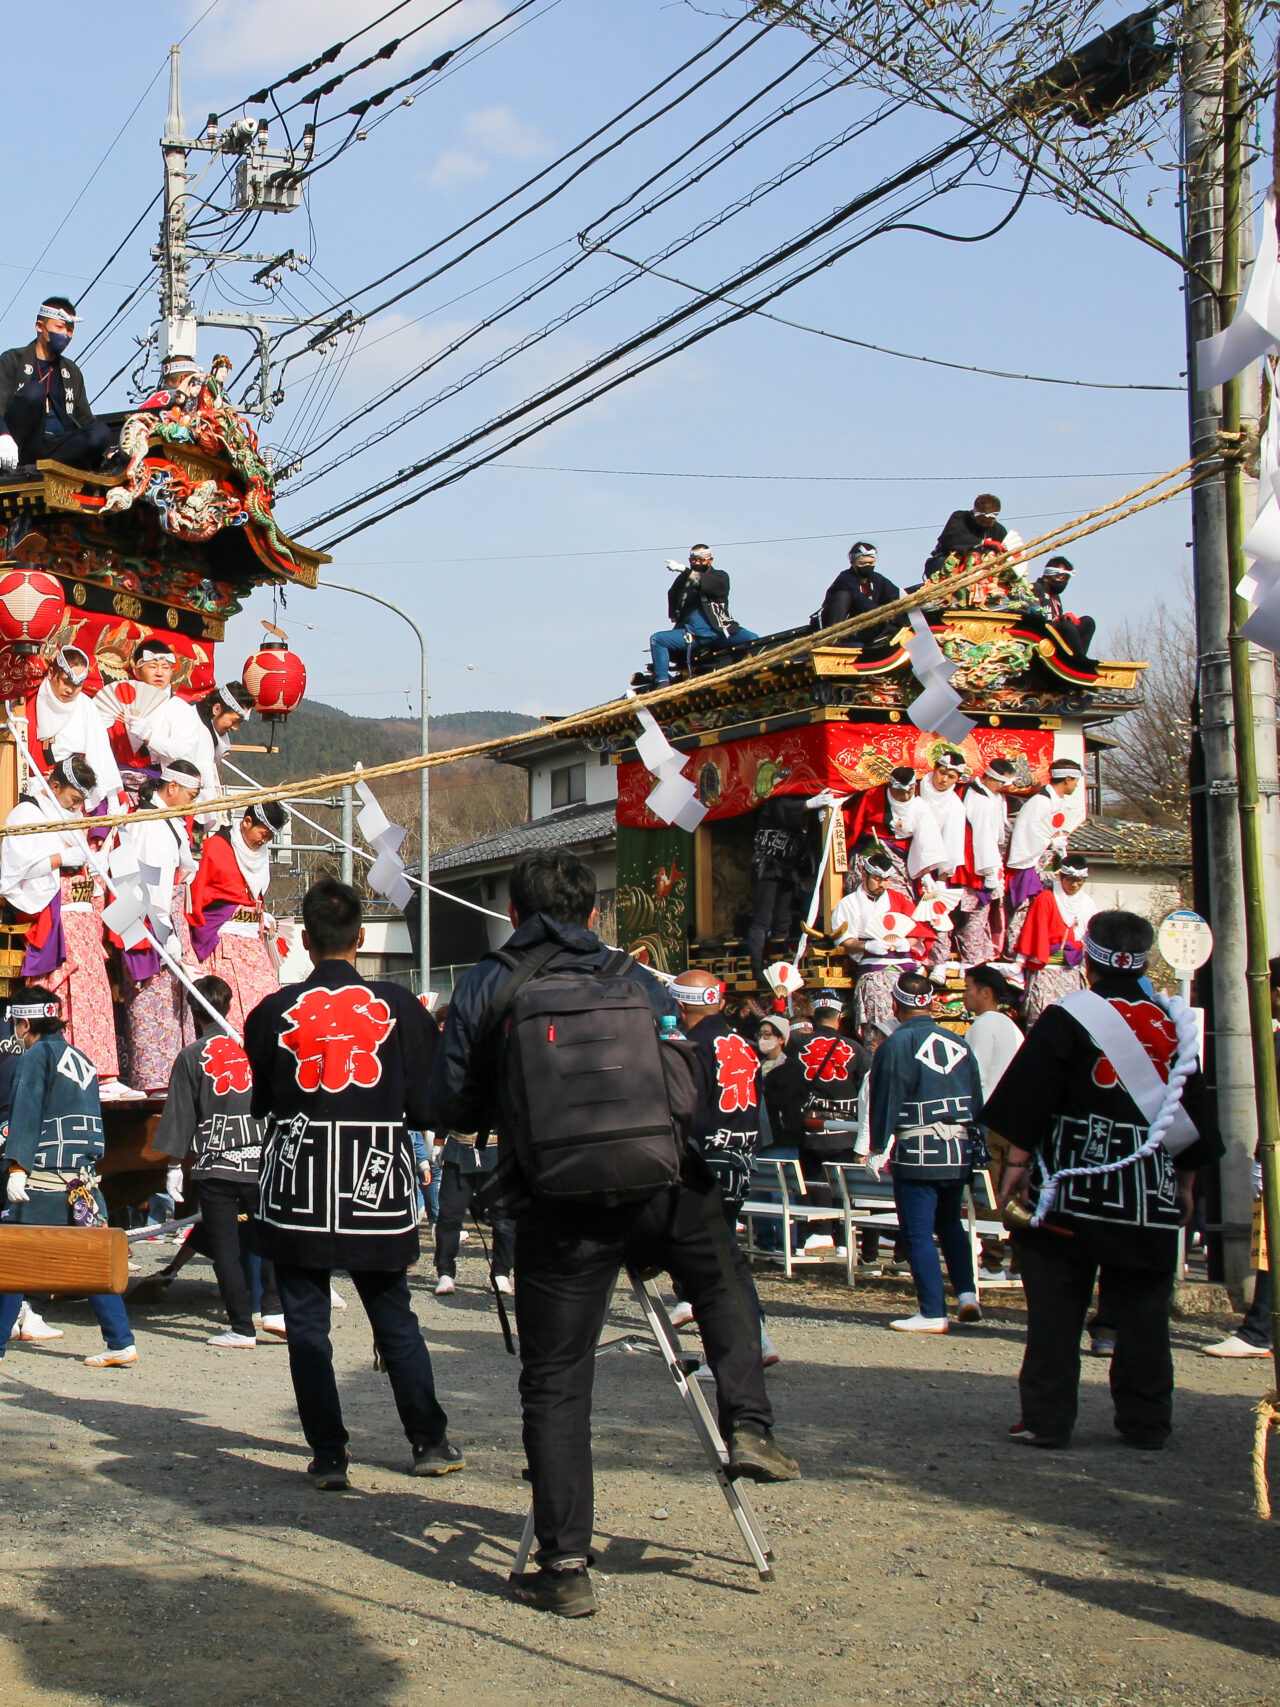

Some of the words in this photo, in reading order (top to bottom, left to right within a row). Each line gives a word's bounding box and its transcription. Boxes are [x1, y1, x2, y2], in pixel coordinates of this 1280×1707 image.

[706, 990, 717, 1003] 本
[278, 985, 396, 1093] 祭
[1087, 1121, 1108, 1158] 本組
[360, 1156, 386, 1200] 本組
